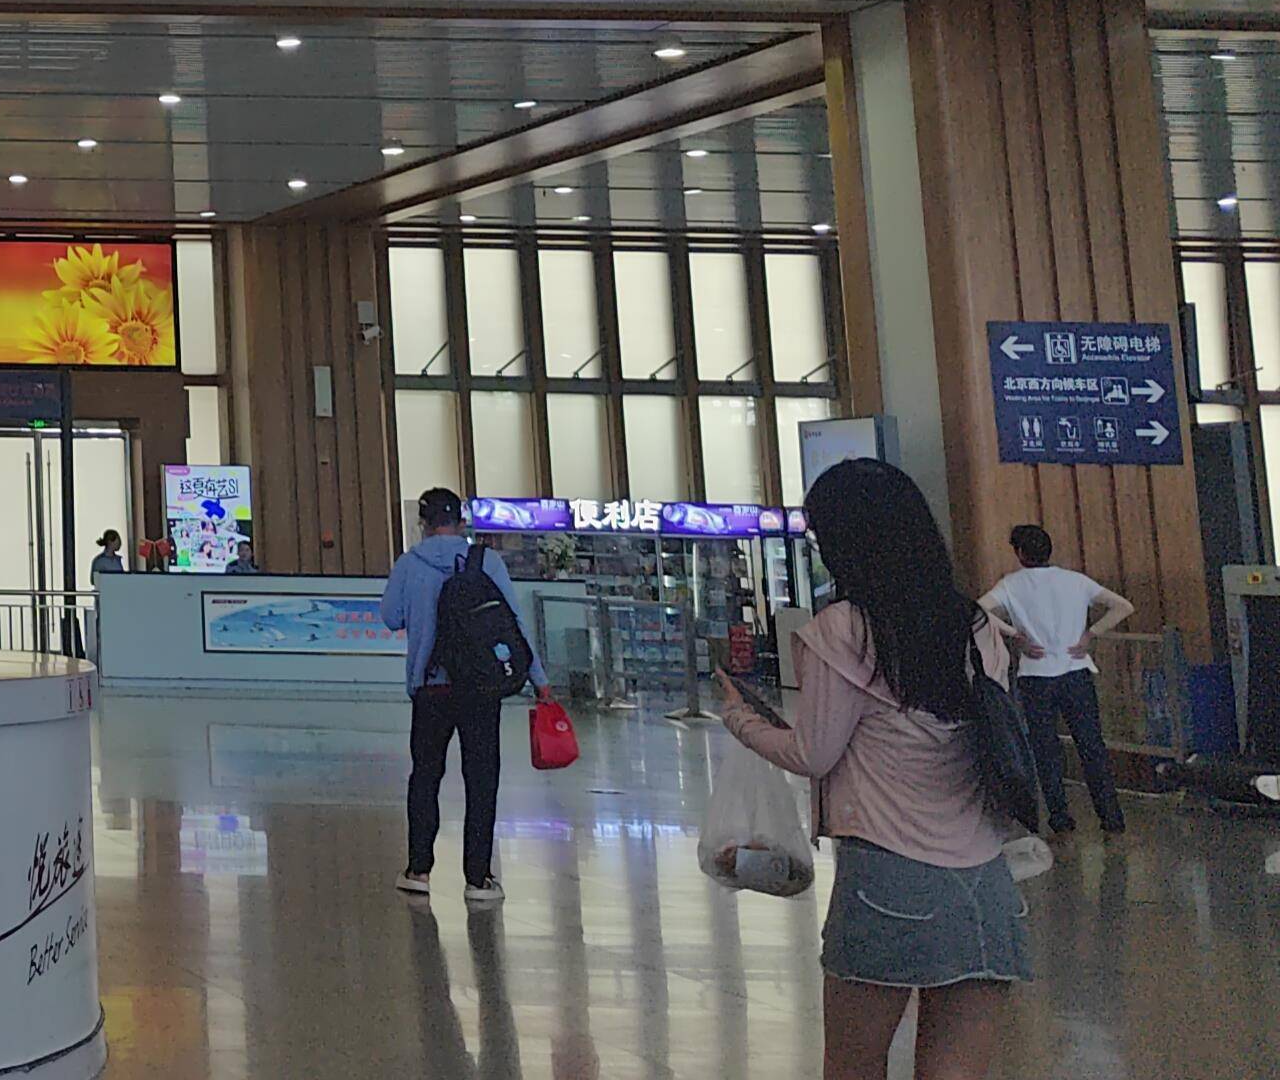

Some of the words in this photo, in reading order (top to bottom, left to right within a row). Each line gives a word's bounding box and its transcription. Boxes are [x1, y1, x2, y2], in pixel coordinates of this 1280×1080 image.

[1081, 336, 1161, 353] 无障碍电梯
[569, 498, 662, 530] 便利店
